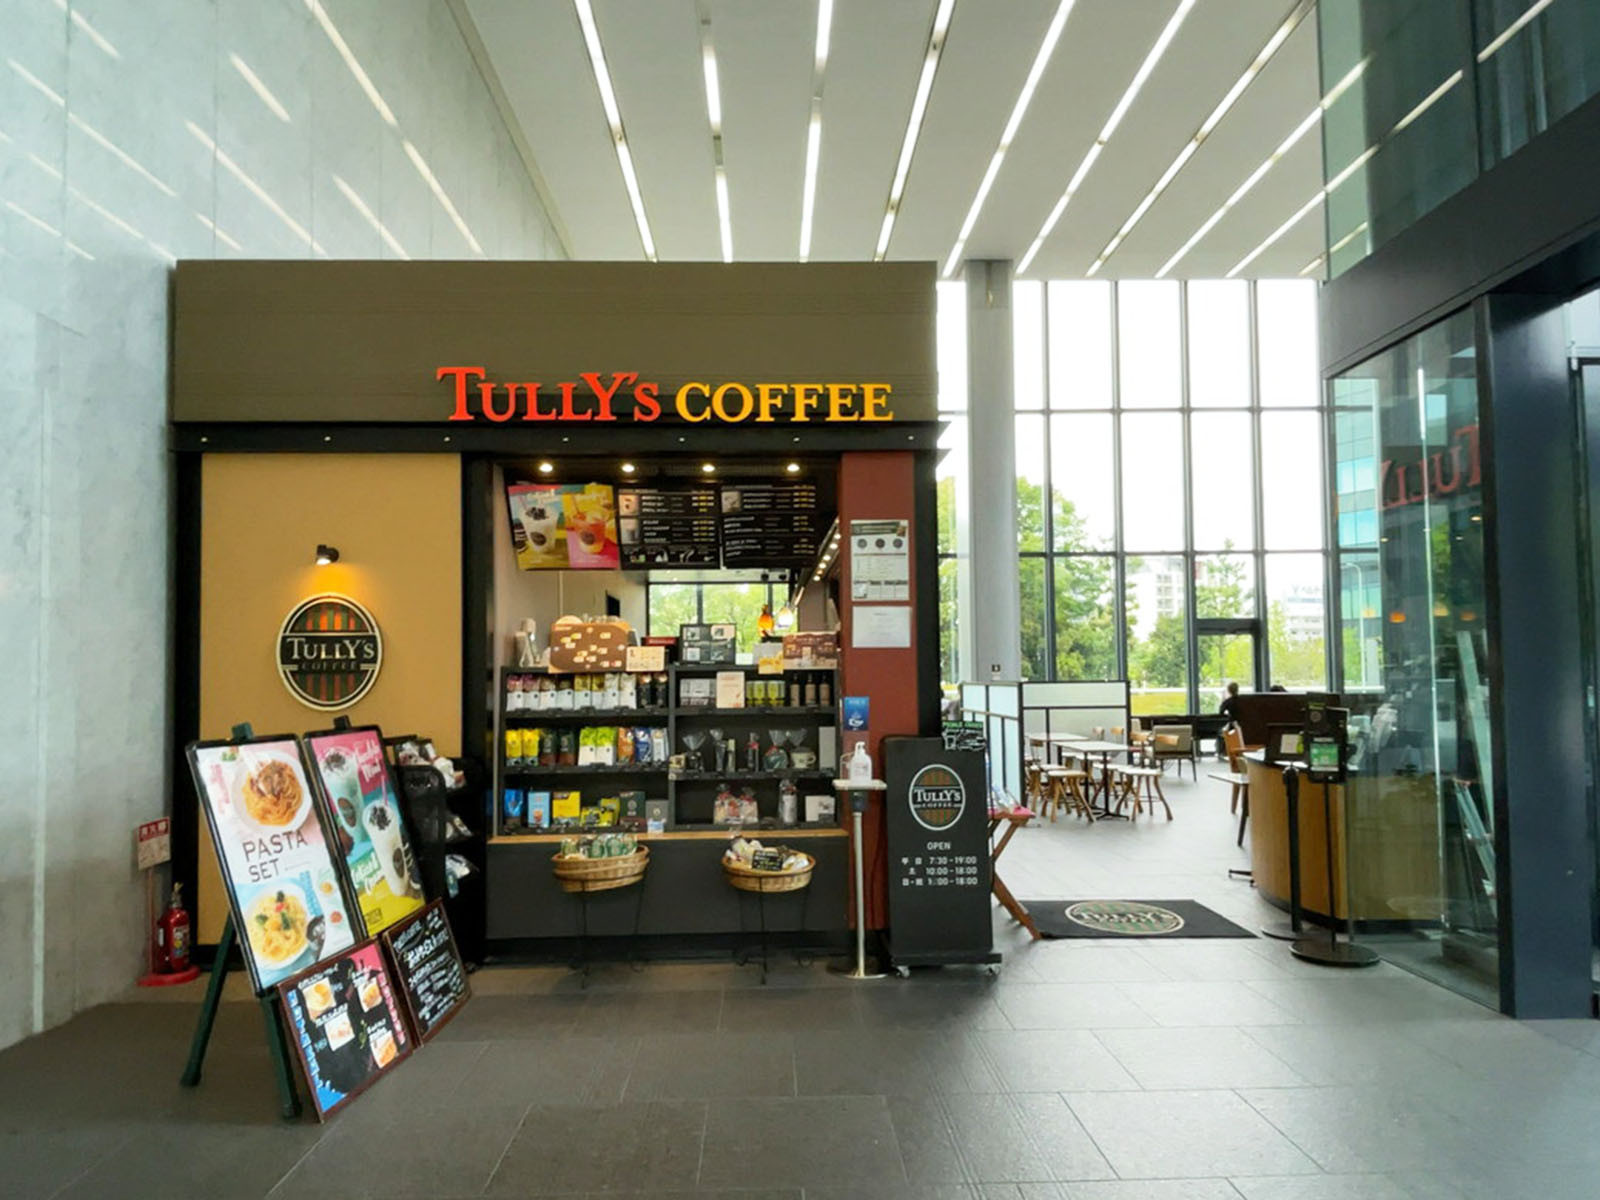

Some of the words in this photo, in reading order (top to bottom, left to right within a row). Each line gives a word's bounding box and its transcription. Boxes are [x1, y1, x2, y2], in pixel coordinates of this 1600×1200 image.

[436, 366, 662, 422] TULLY'S
[675, 382, 894, 423] COFFEE
[286, 637, 375, 660] TULLY'S
[914, 788, 961, 802] TULLY'S
[242, 828, 308, 863] PASTA
[926, 841, 952, 851] OPEN
[248, 857, 280, 883] SET
